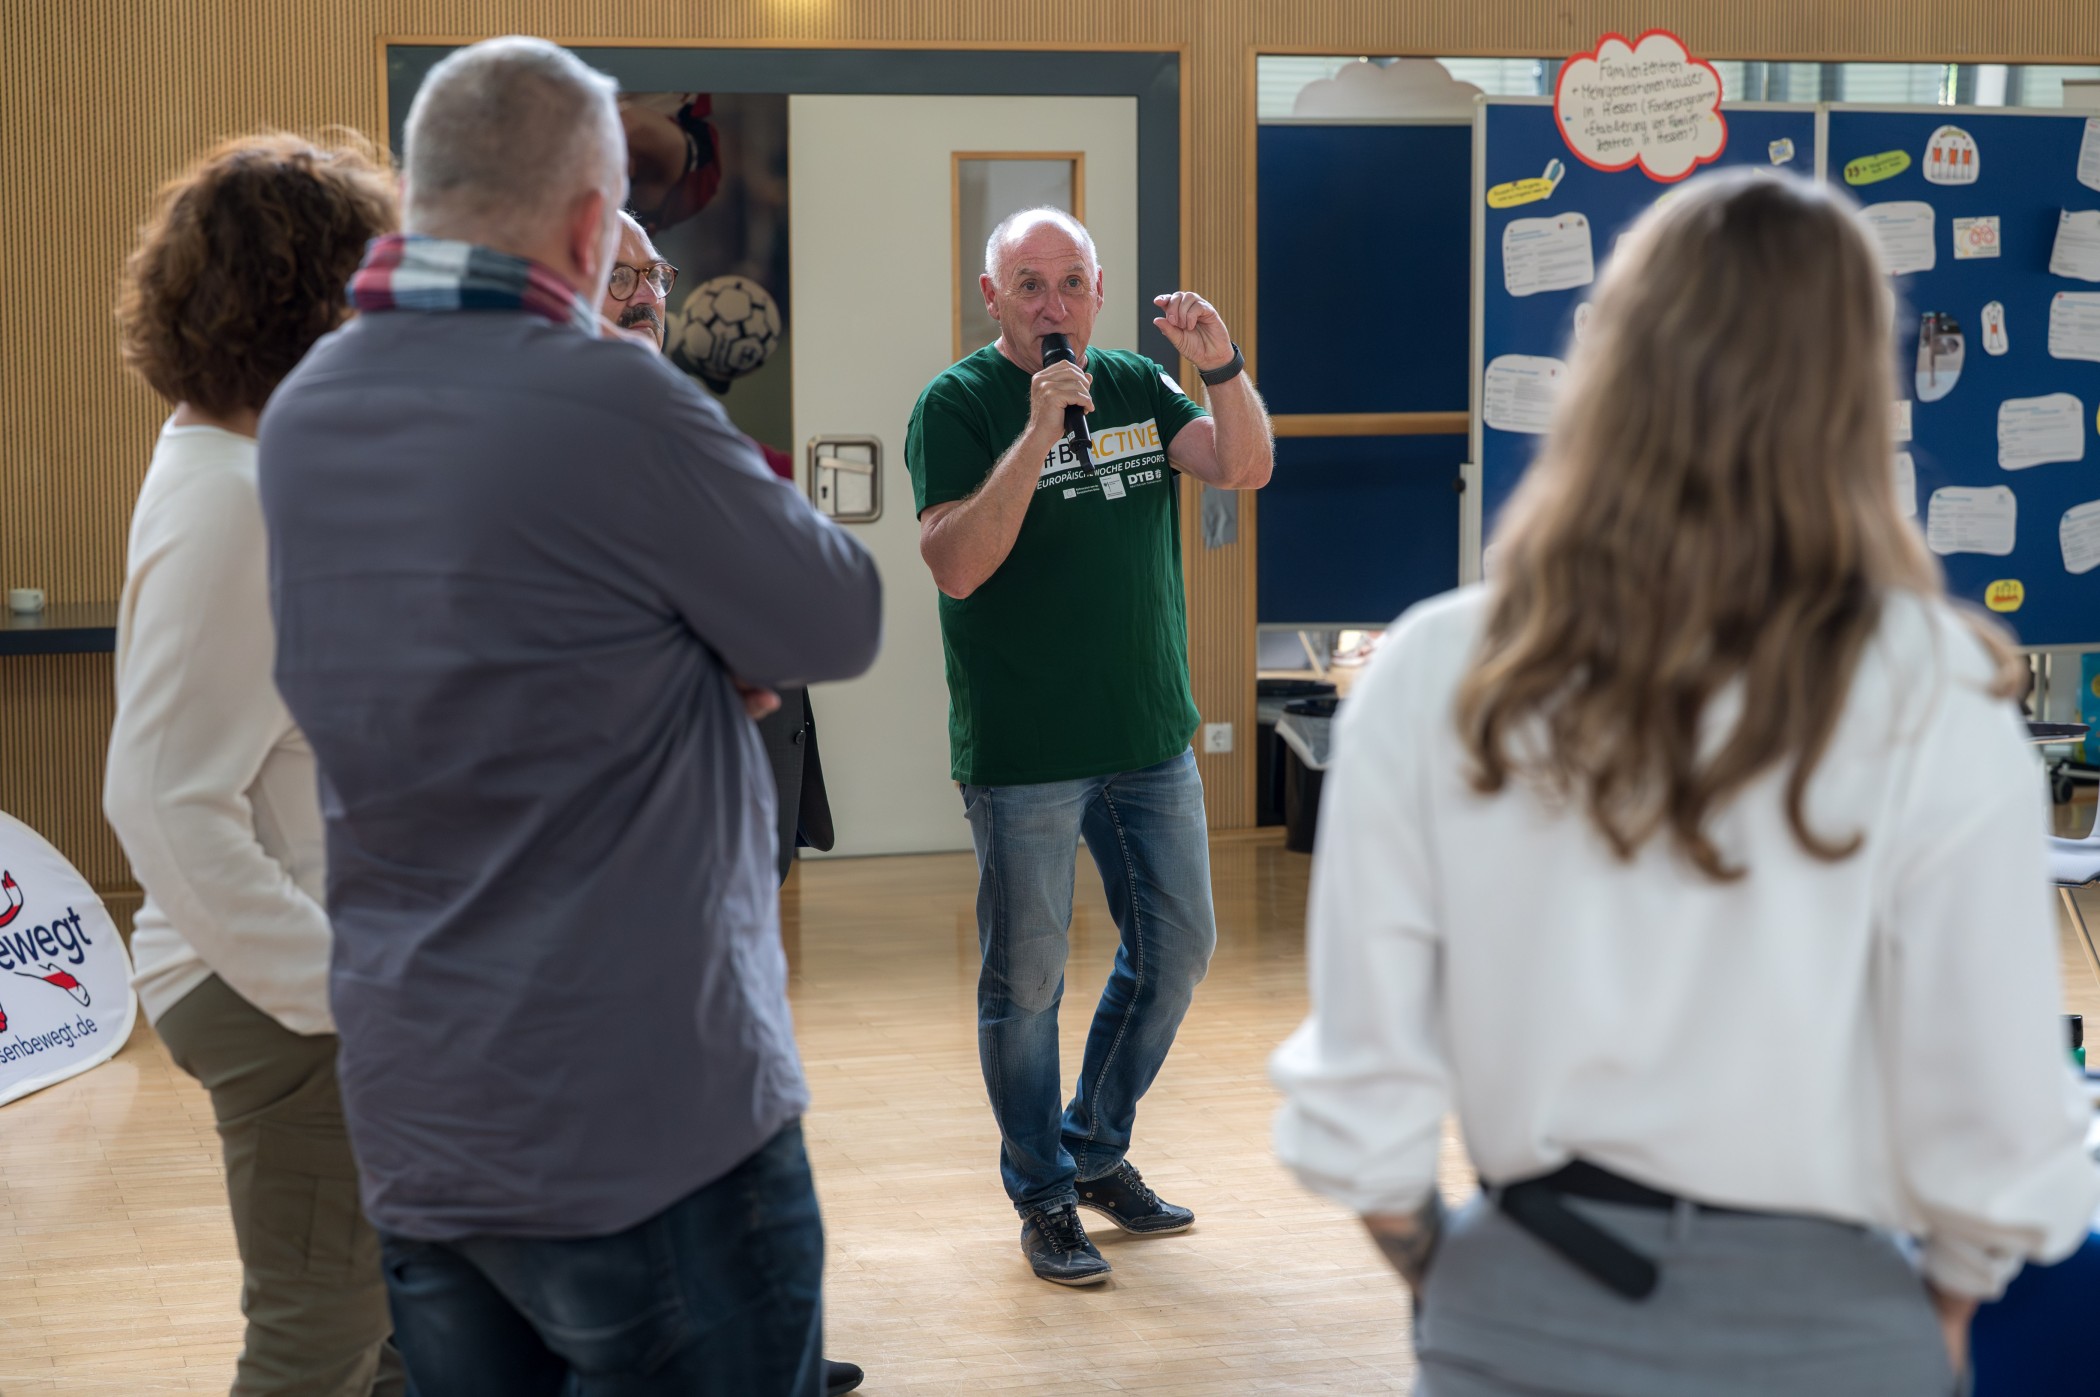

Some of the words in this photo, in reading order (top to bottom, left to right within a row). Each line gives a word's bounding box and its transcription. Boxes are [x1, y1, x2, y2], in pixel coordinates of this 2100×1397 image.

[1602, 101, 1637, 117] Hessen
[1036, 470, 1094, 490] EUROPÄISC
[1124, 458, 1141, 470] DES
[1127, 470, 1155, 485] DTB
